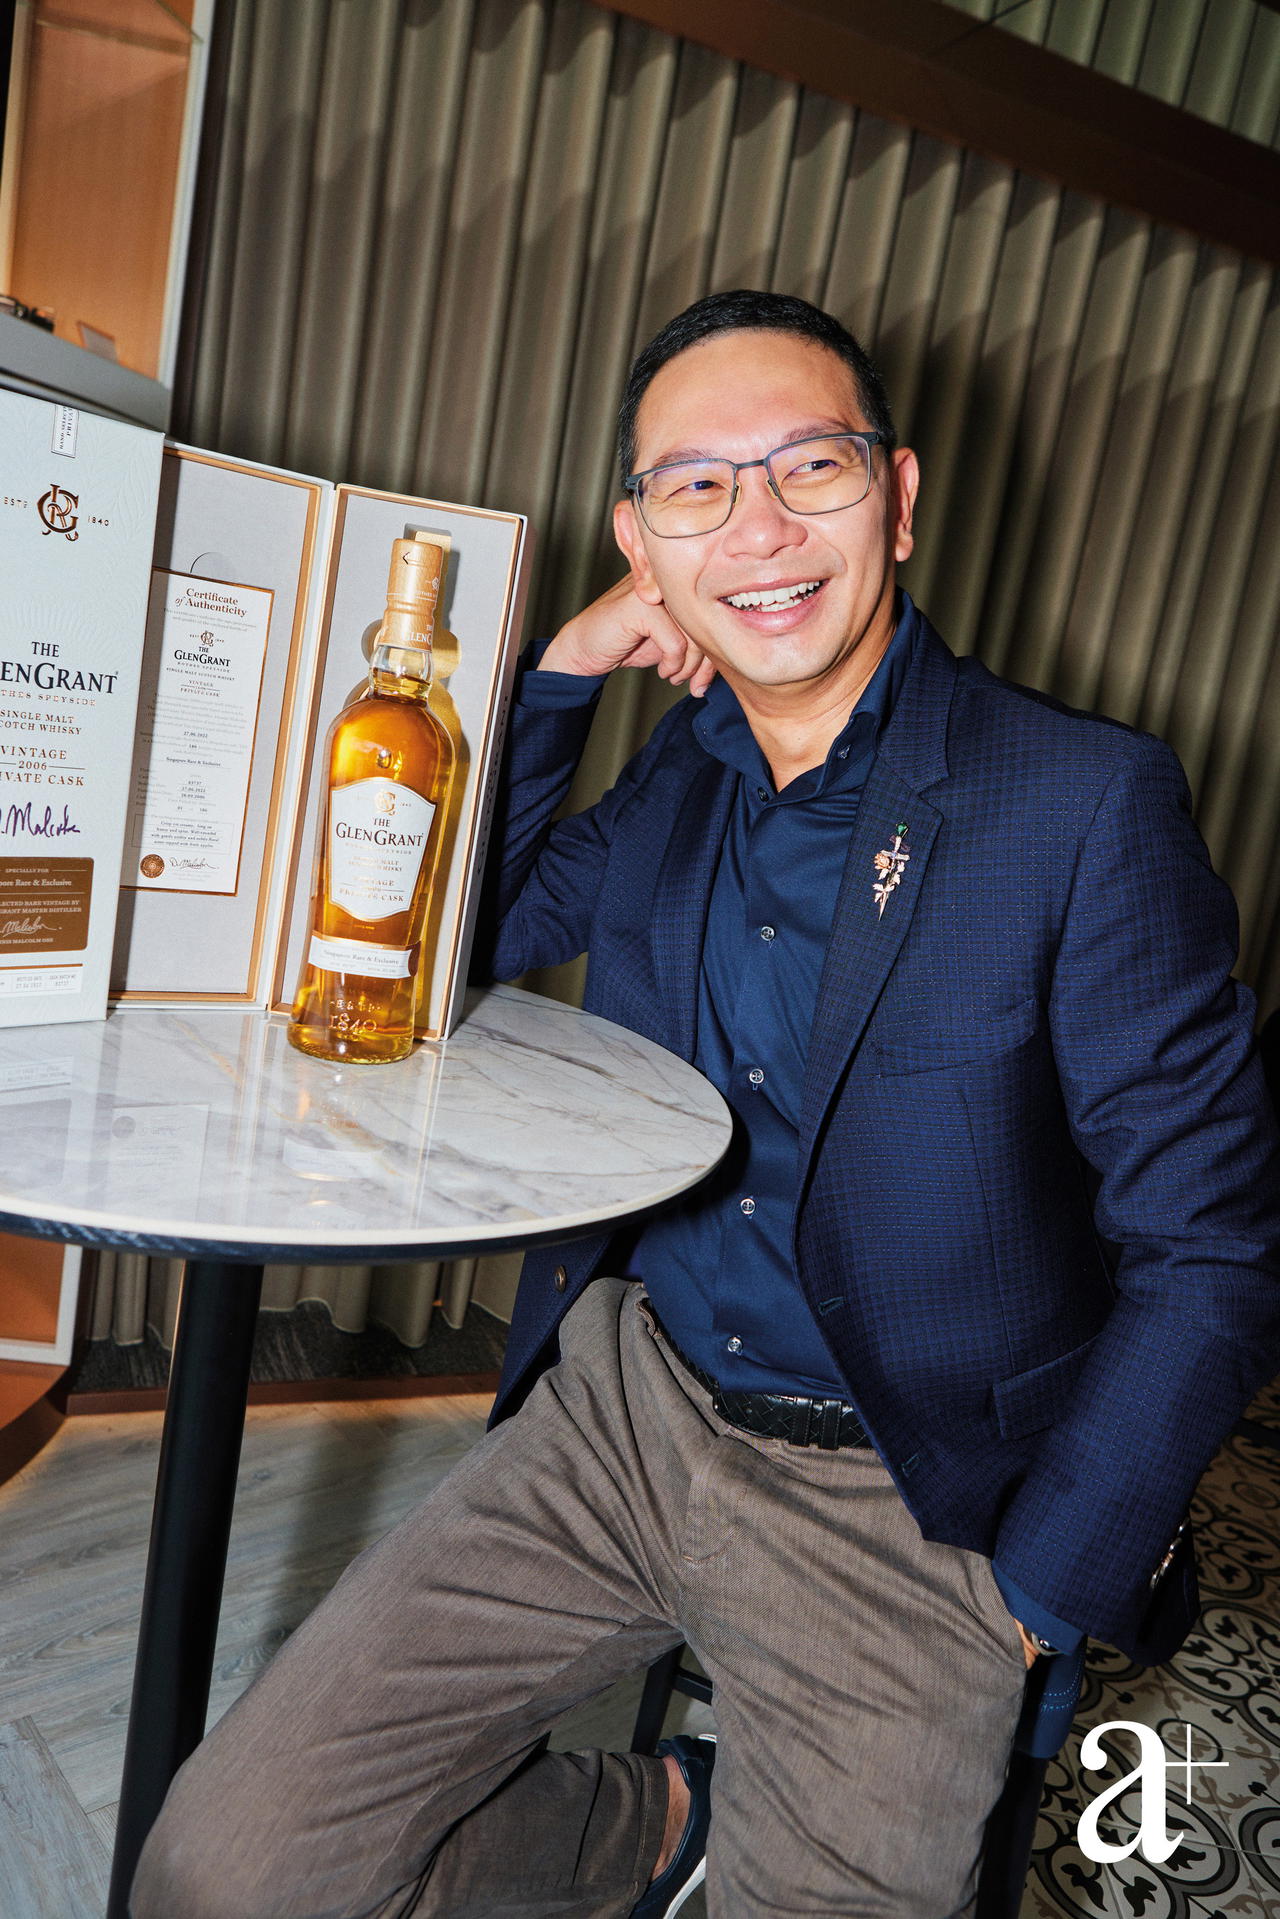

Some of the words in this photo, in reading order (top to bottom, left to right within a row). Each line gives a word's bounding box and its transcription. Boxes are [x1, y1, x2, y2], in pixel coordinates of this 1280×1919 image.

[186, 588, 238, 606] Certificate
[185, 598, 247, 617] Authenticity
[31, 641, 60, 658] THE
[174, 649, 231, 667] GLENGRANT
[0, 661, 117, 694] ENGRANT
[38, 693, 97, 706] SPEYSIDE
[0, 709, 41, 721] SINGLE
[45, 713, 74, 724] MALT
[39, 723, 82, 735] WHISKY
[1, 745, 67, 760] VINTAGE
[18, 760, 47, 770] 2006
[47, 774, 84, 786] CASK
[373, 817, 391, 827] THE
[335, 822, 422, 847] GLENGRANT
[32, 879, 41, 887] &
[41, 878, 72, 886] Exclusive
